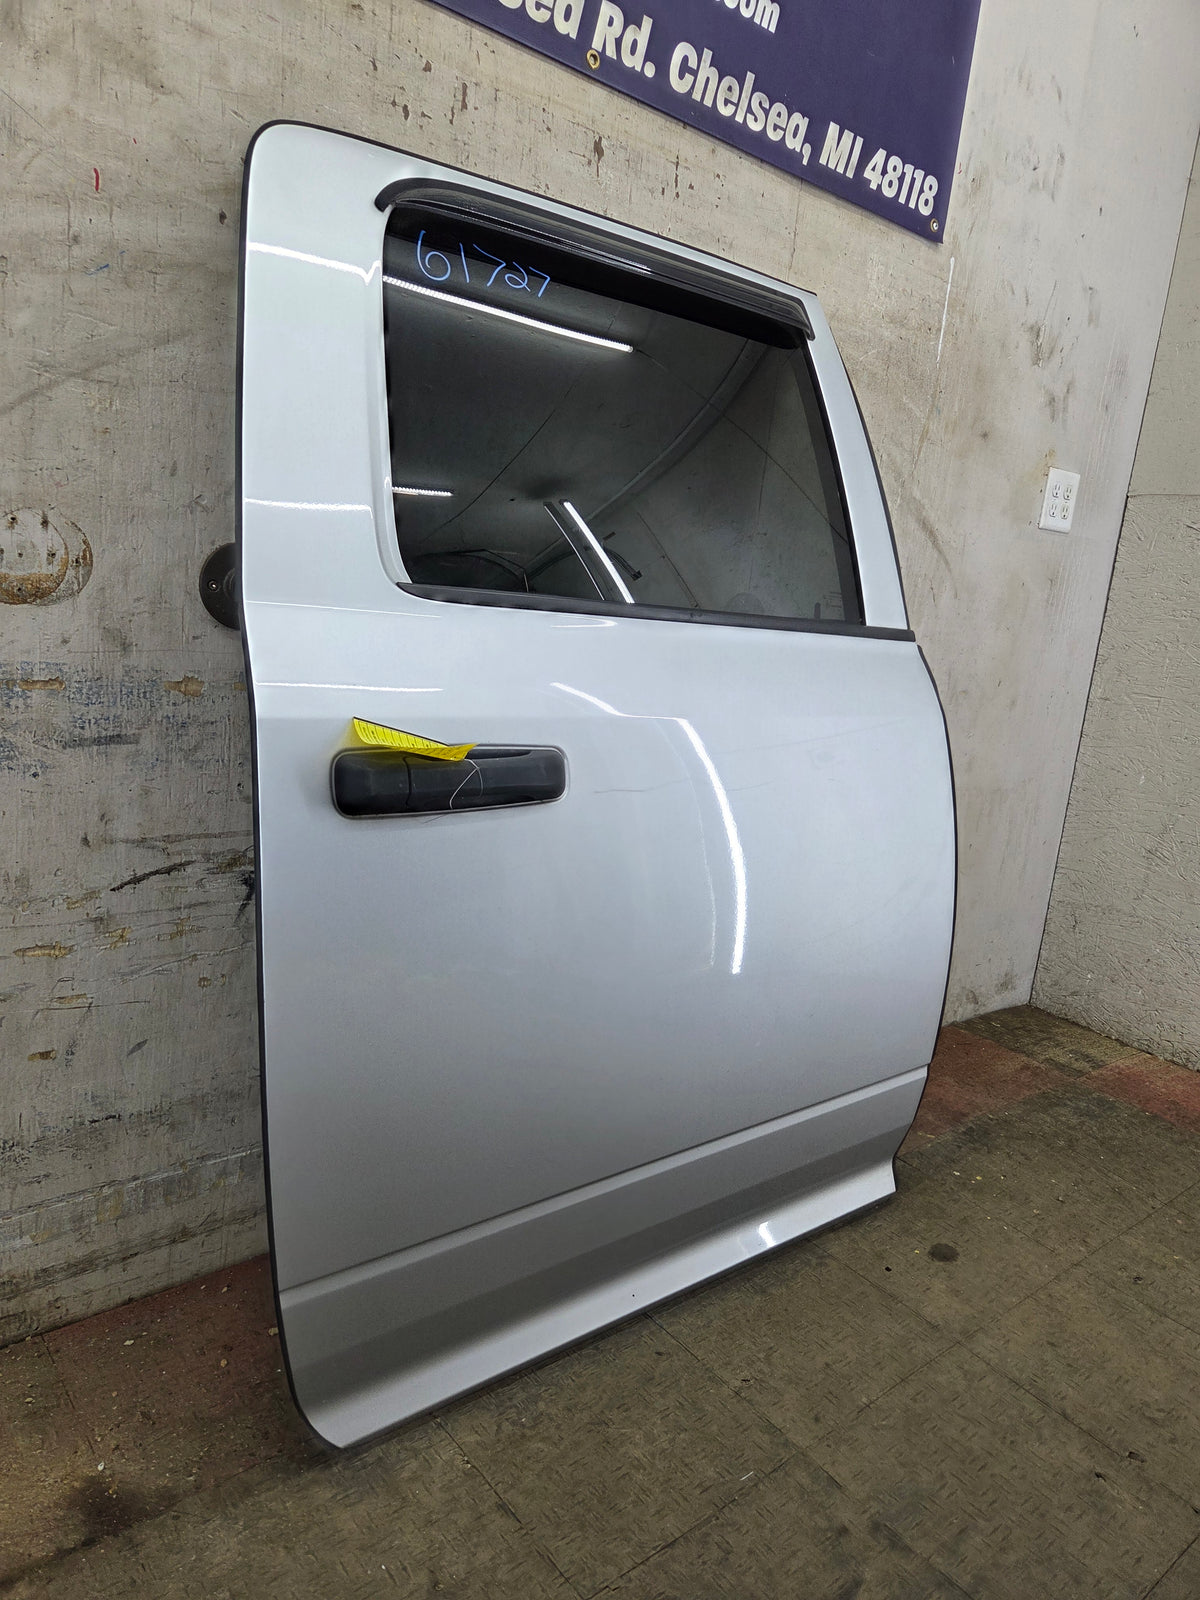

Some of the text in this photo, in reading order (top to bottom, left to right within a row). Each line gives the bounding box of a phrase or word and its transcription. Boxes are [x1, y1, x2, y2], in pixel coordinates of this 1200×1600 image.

[498, 0, 939, 217] ea Rd. Chelsea, MI 48118
[416, 230, 550, 298] 61727
